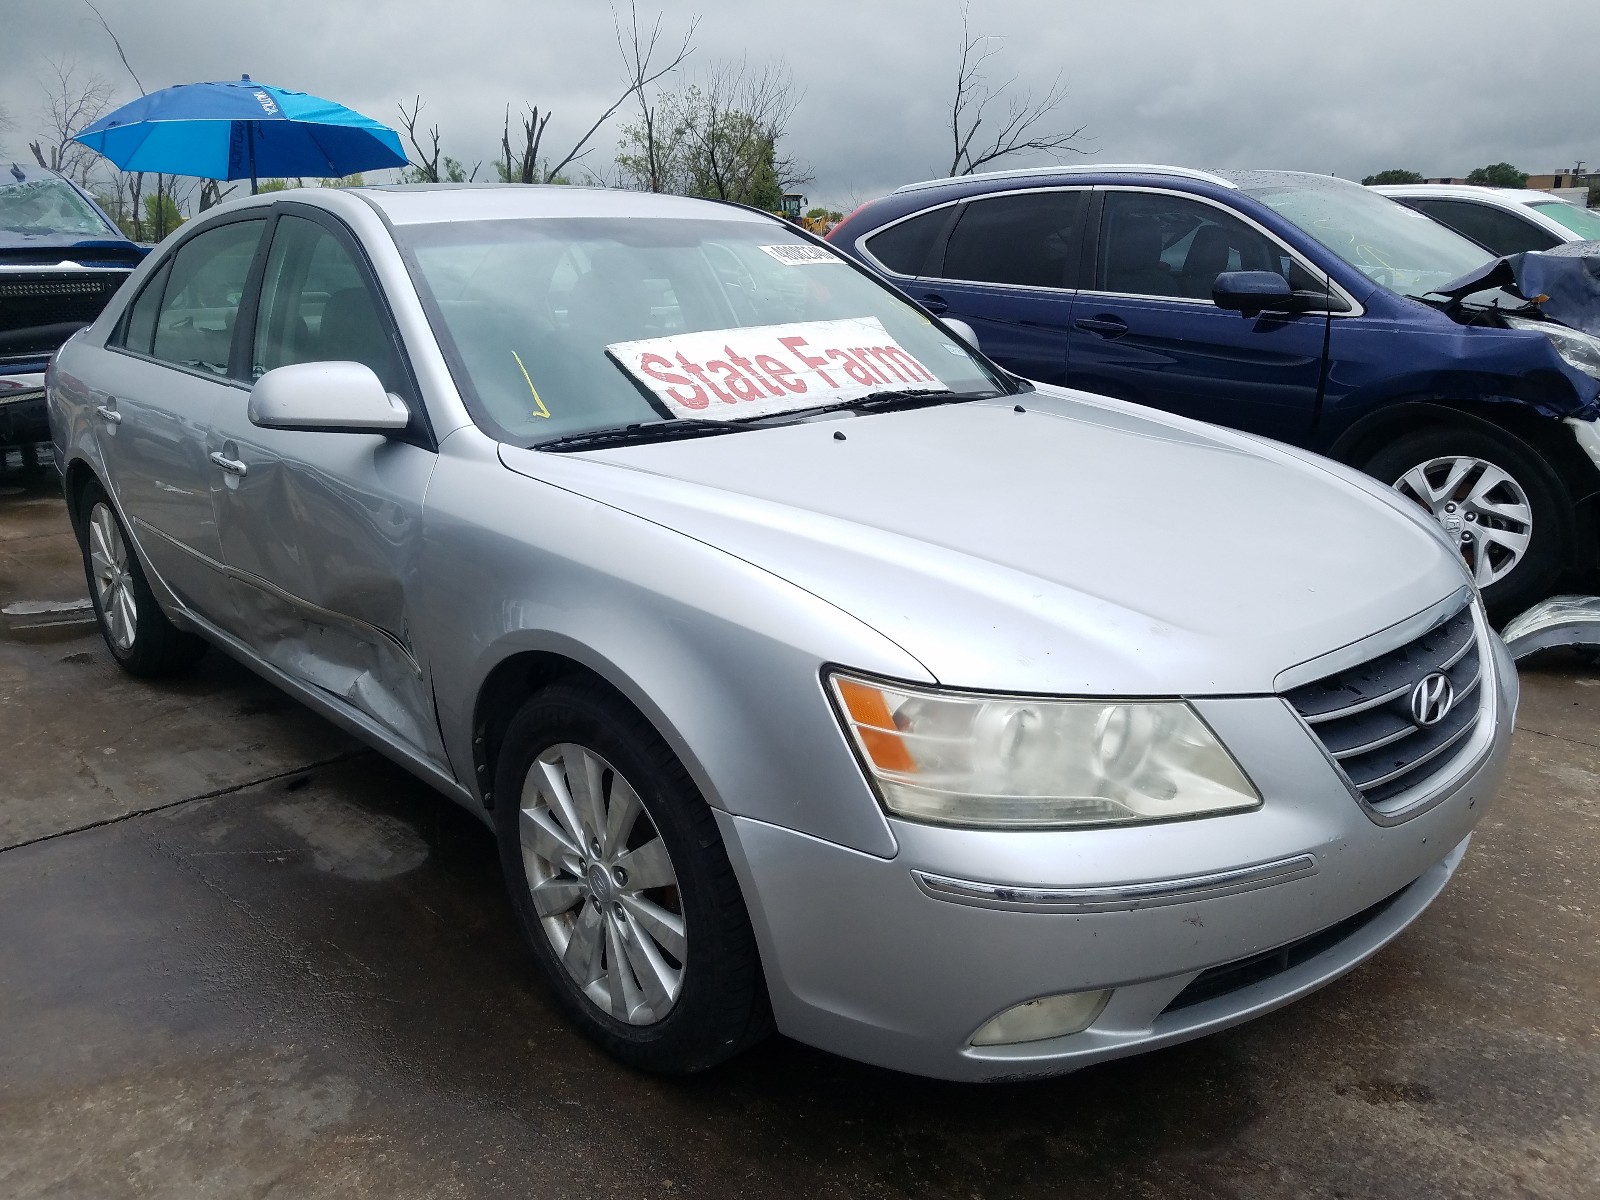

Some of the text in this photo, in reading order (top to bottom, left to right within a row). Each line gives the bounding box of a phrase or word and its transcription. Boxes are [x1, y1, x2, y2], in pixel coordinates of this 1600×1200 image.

[771, 246, 834, 260] 48082340
[641, 336, 936, 411] State Farm
